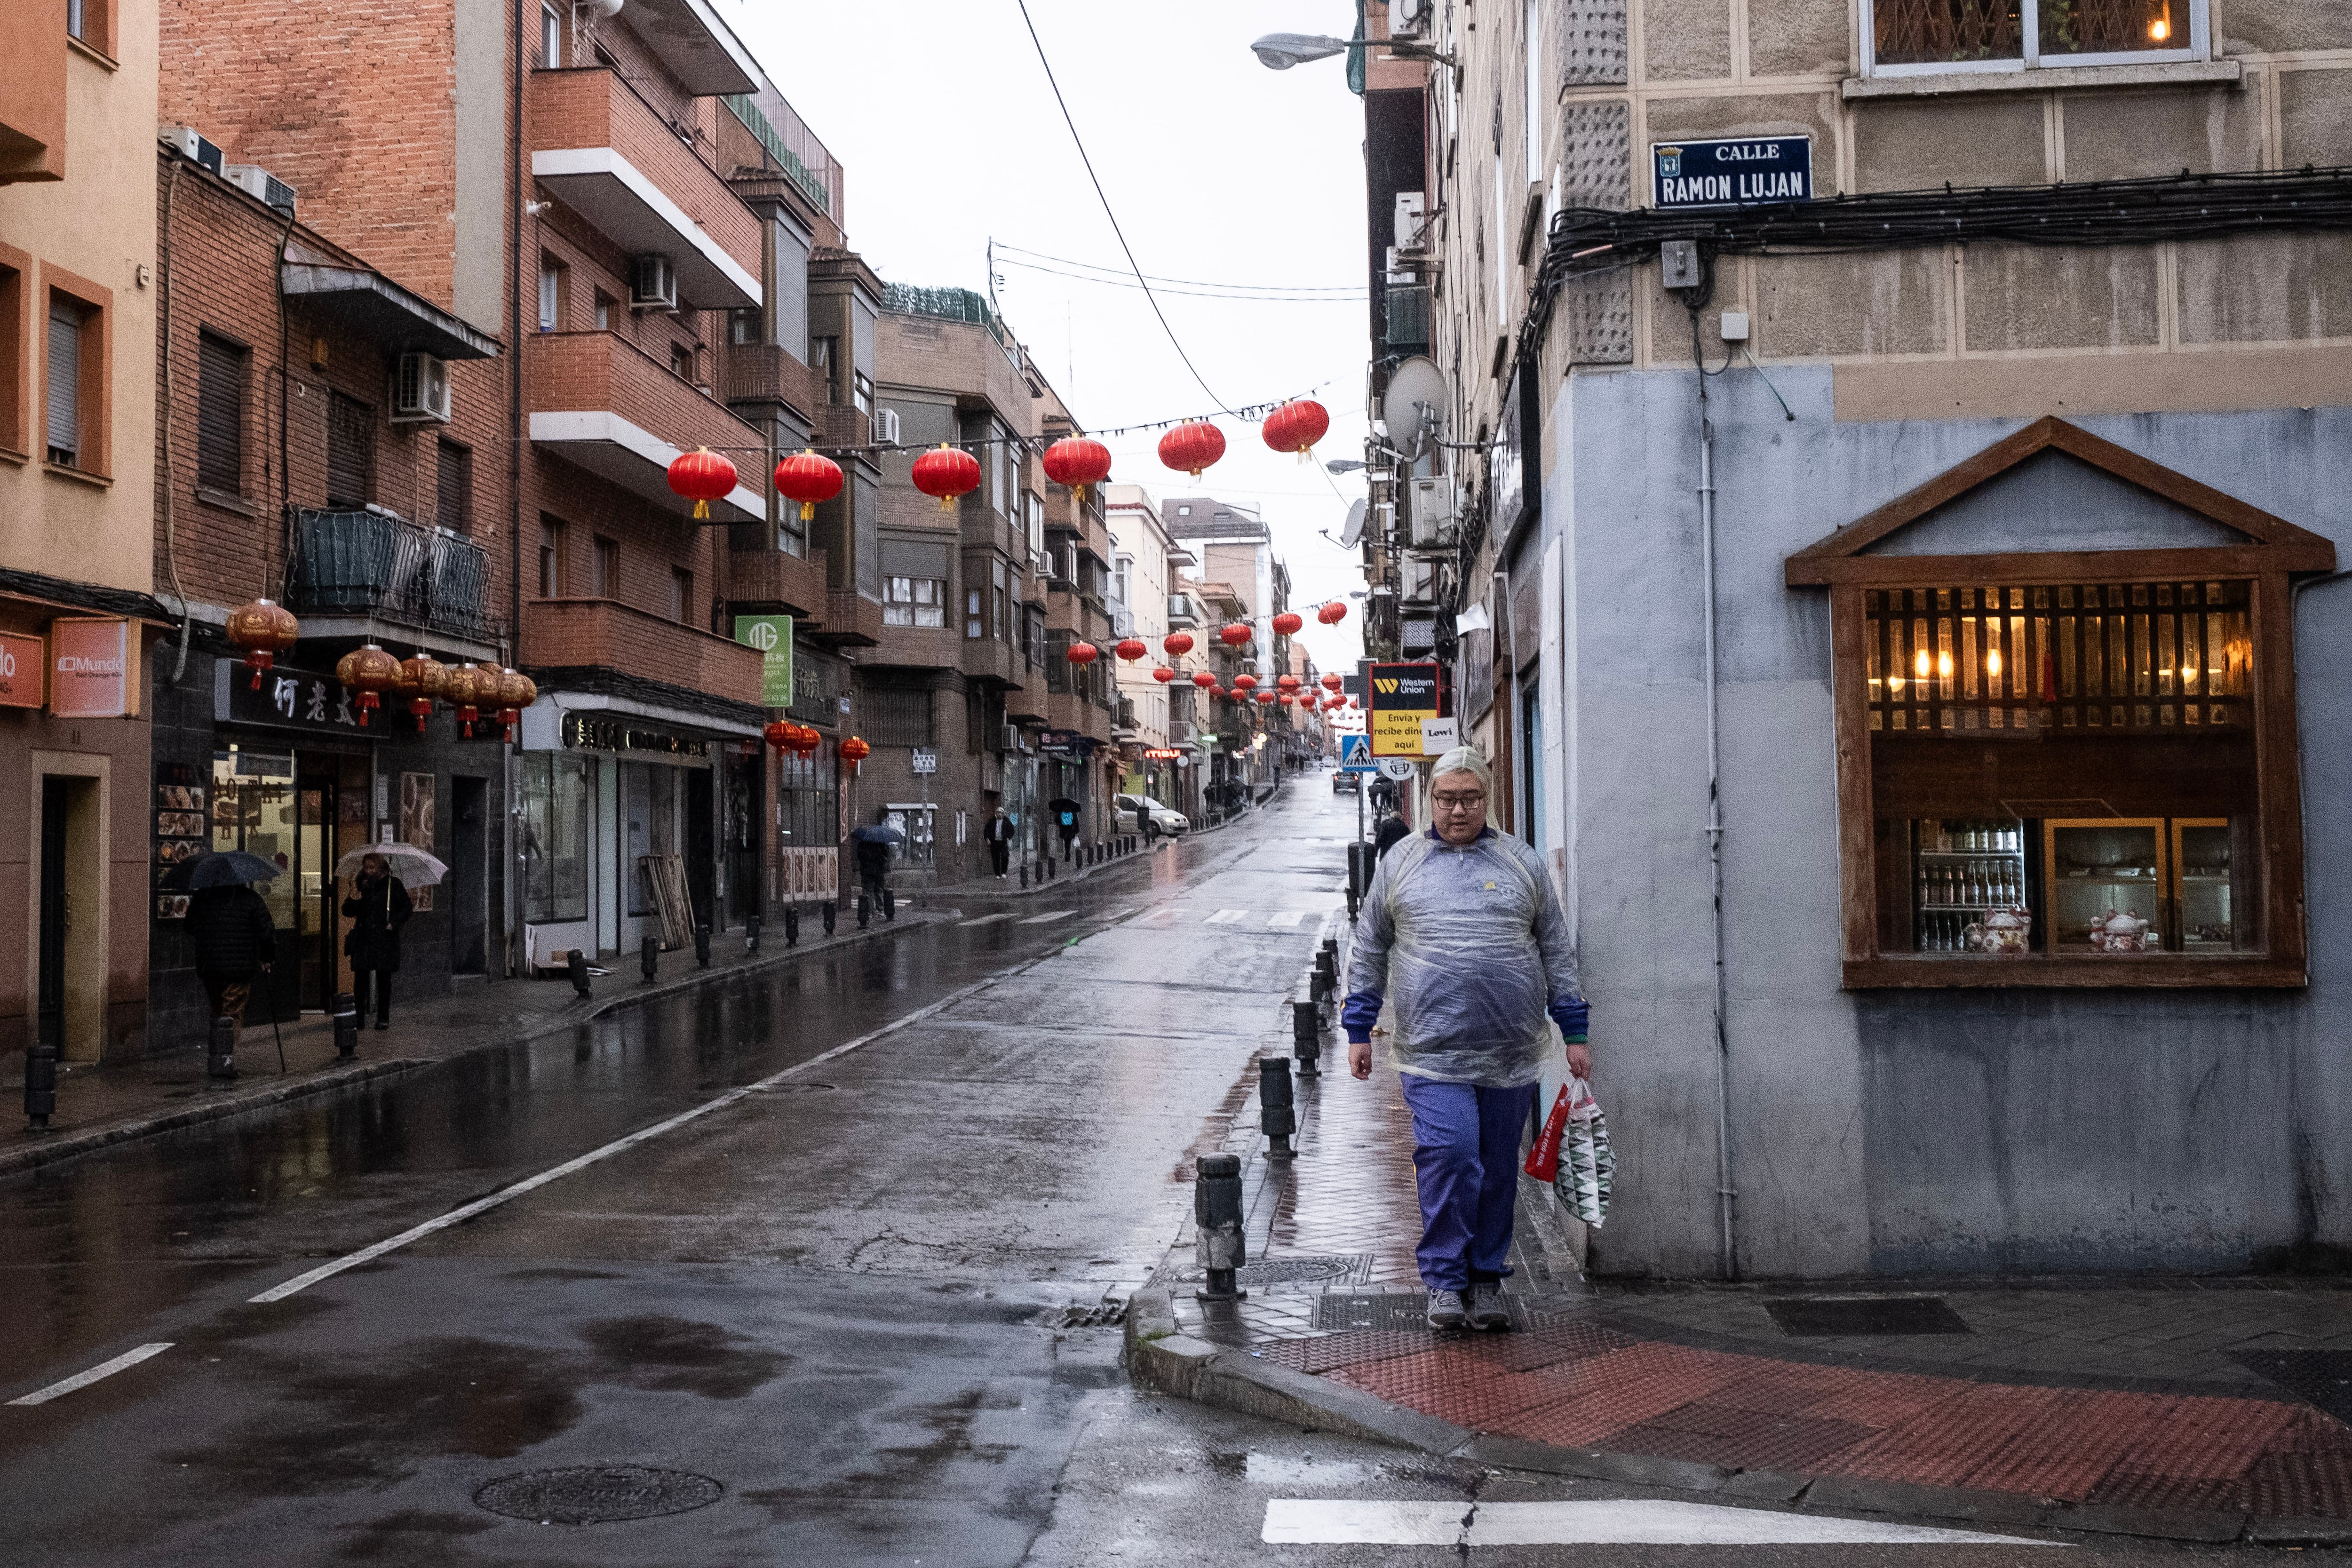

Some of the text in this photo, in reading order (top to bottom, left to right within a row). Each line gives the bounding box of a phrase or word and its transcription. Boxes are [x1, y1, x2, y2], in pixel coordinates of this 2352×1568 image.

[1716, 144, 1780, 161] CALLE
[1663, 172, 1803, 202] RAMON LUJAN
[1388, 713, 1420, 724] Envía y
[1374, 726, 1402, 735] recibe
[1394, 740, 1414, 750] aquí
